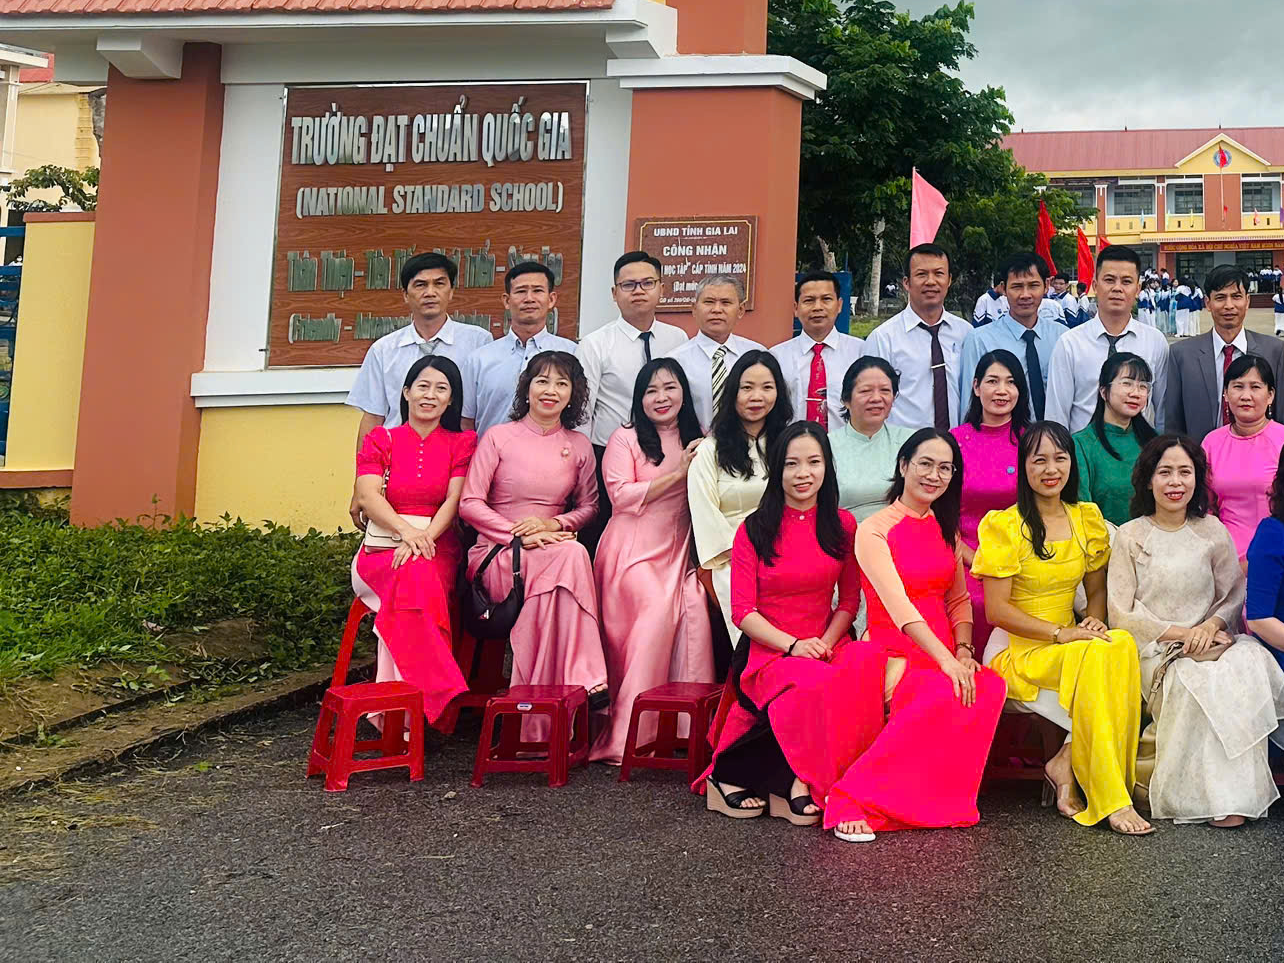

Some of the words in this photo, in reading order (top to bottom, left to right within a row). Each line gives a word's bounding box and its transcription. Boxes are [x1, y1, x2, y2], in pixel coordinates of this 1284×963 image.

[291, 101, 368, 166] TRƯỜNG
[370, 114, 409, 172] ĐẠT
[411, 94, 479, 163] CHUẨN
[481, 95, 535, 167] QUỐC
[537, 111, 572, 161] GIA
[296, 186, 389, 219] (NATIONAL
[391, 183, 485, 214] STANDARD
[489, 181, 564, 214] SCHOOL)
[654, 228, 680, 237] UBND
[706, 227, 721, 235] GIA
[724, 226, 738, 235] LAI
[663, 244, 693, 256] CÔNG
[696, 244, 727, 257] NHẬN
